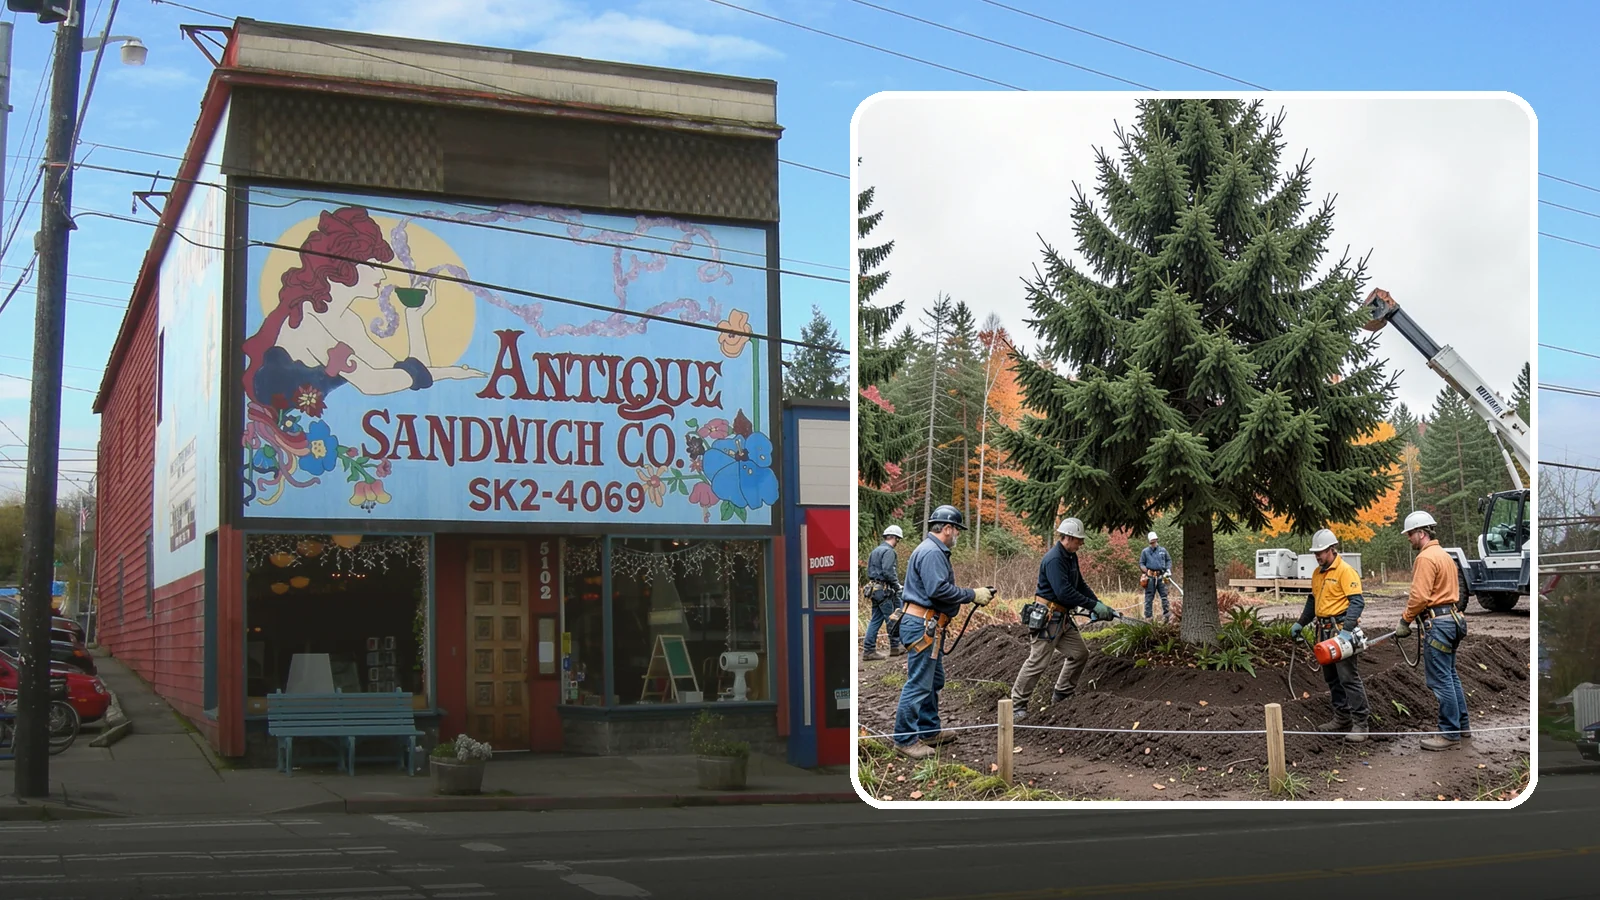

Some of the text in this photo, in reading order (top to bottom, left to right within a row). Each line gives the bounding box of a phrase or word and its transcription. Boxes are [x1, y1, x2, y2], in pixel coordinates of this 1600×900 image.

[476, 329, 724, 421] ANTIQUE
[361, 409, 685, 468] SANDWICH CO.
[468, 477, 646, 513] SK2-4069
[539, 541, 552, 600] 5102
[809, 555, 835, 569] BOOKS
